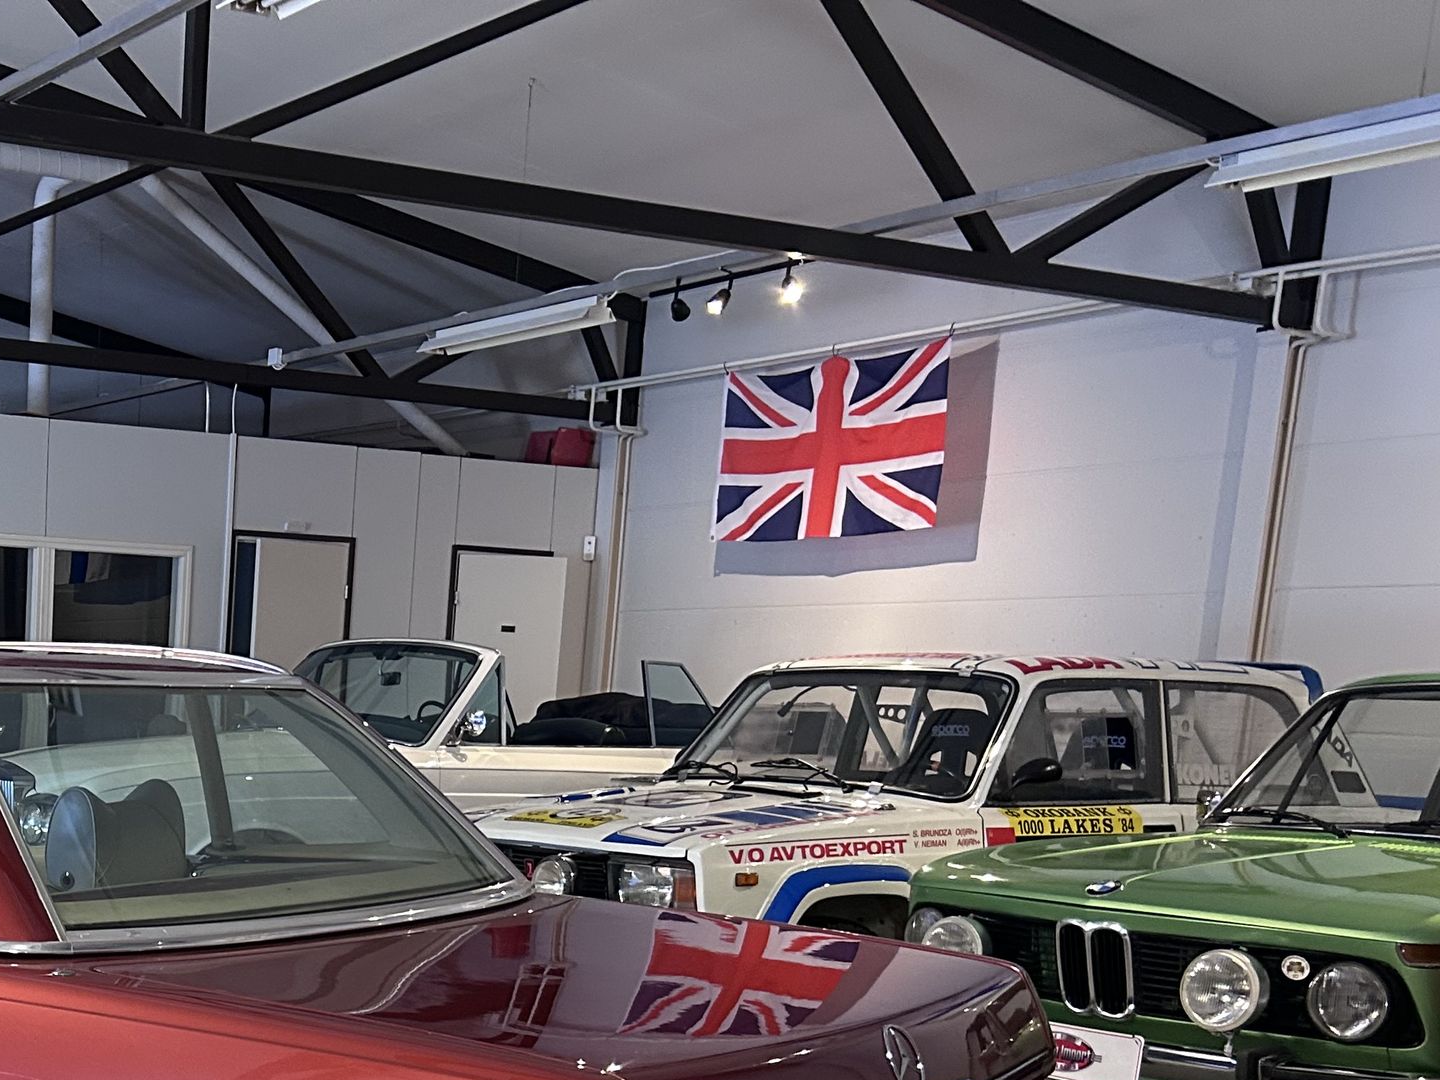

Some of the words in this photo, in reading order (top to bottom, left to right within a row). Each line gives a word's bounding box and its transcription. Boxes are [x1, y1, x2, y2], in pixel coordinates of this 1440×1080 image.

[1004, 656, 1124, 675] LADA
[1018, 819, 1044, 834] 1000
[1048, 818, 1114, 834] LAKES
[1118, 817, 1135, 832] '84
[769, 839, 907, 862] AVTOEXPORT
